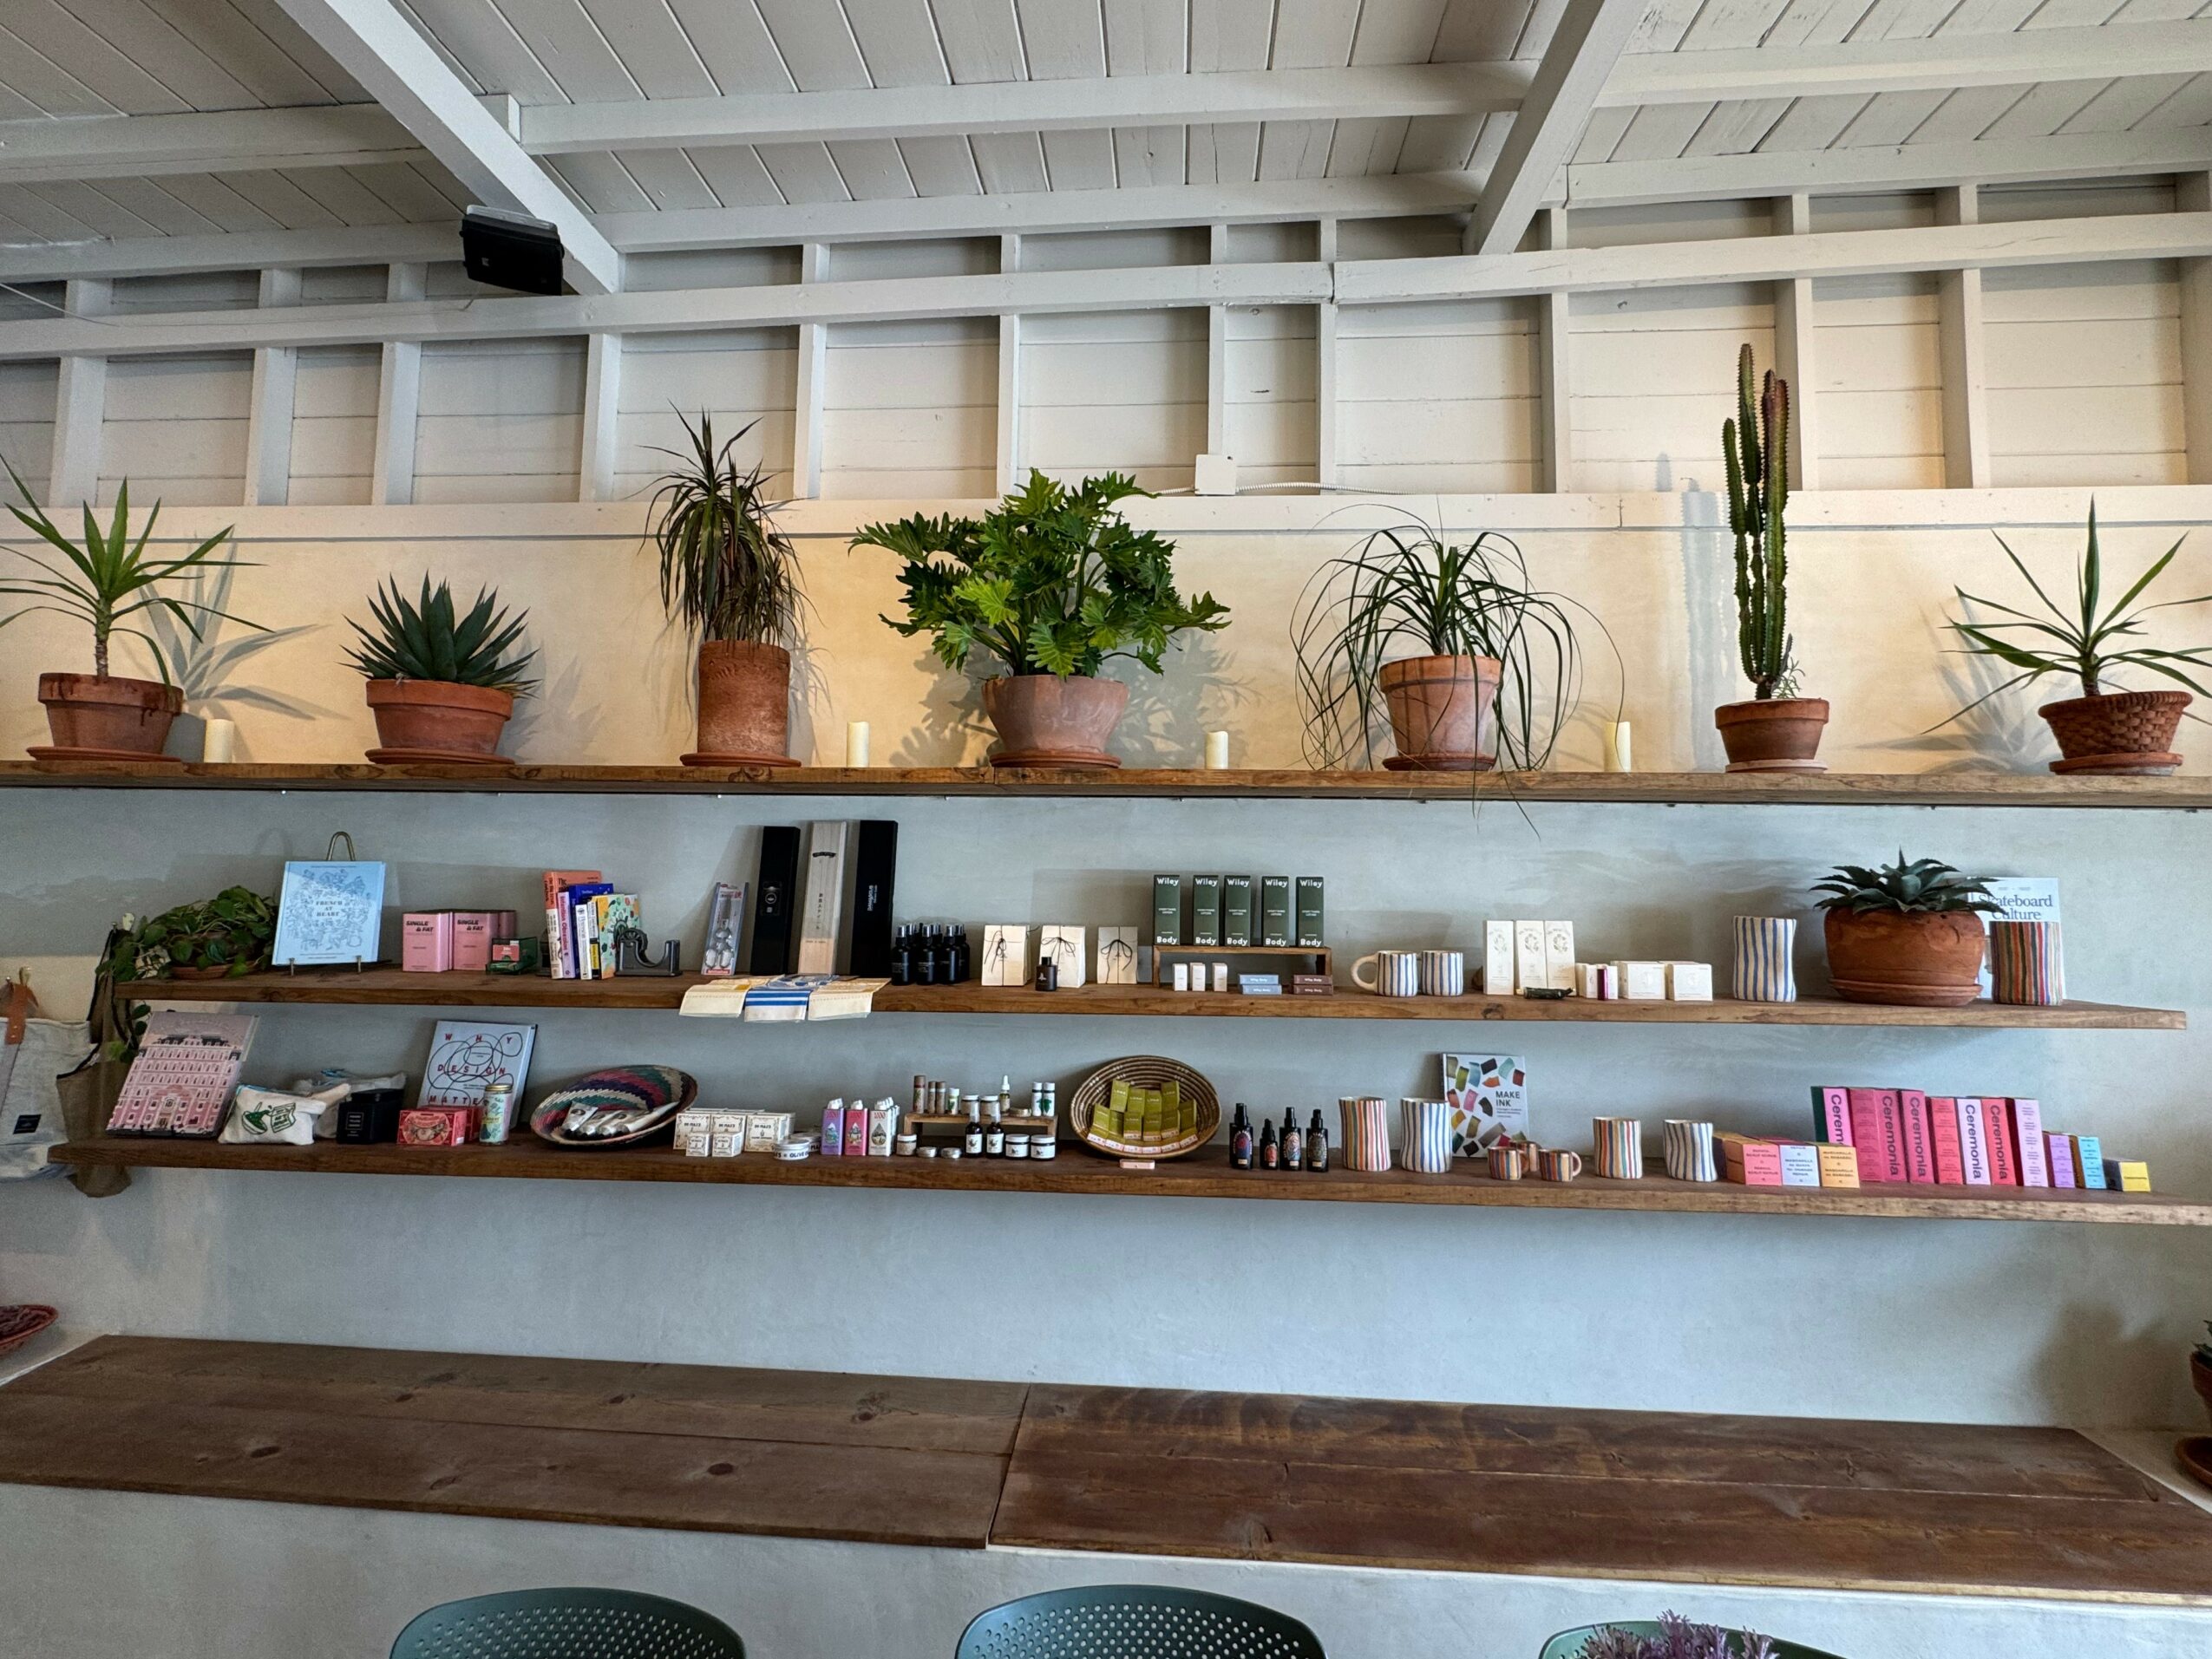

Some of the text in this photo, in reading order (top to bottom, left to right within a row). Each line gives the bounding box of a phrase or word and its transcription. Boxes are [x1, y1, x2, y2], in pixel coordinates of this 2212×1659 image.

[1156, 878, 1179, 886] Wiley
[1195, 878, 1218, 886] Wiley
[1227, 878, 1249, 887] Wiley
[1265, 879, 1287, 888] Wiley
[1299, 879, 1322, 888] Wiley
[1227, 937, 1247, 946] Body
[1300, 938, 1321, 947] Body
[445, 1033, 512, 1044] WHY
[437, 1064, 506, 1074] DESIGN
[1495, 1090, 1520, 1099] MAKE
[1830, 1094, 1845, 1145] Cerem
[1882, 1095, 1901, 1176] Ceremonia
[1910, 1097, 1927, 1177] Ceremonia
[1965, 1104, 1982, 1179] Ceremonia
[1990, 1105, 2008, 1179] Ceremonia
